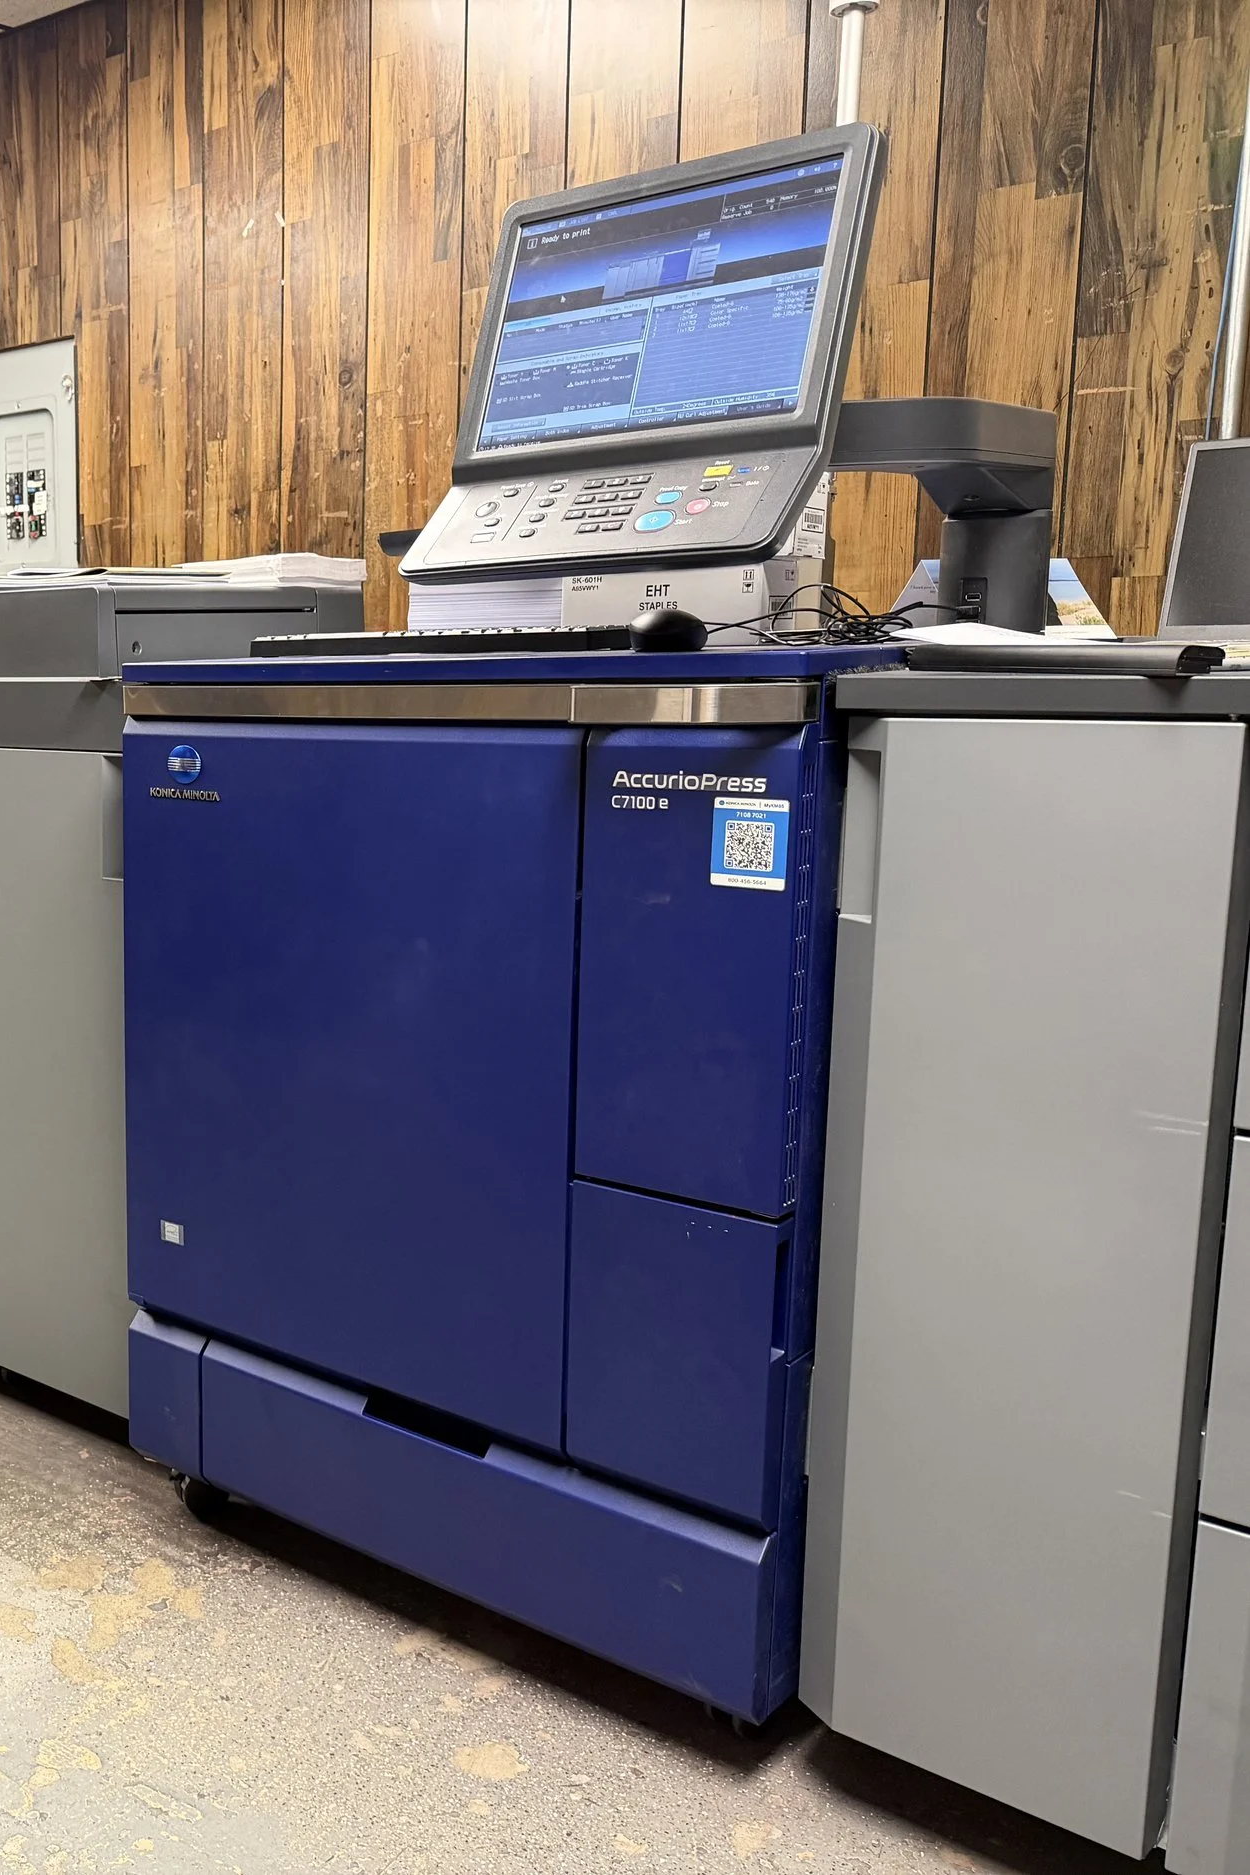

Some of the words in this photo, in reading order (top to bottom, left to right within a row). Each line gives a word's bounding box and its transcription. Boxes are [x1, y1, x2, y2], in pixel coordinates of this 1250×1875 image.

[541, 234, 560, 245] Ready
[572, 227, 591, 240] print
[638, 416, 665, 424] Controller
[698, 408, 726, 417] Adjustment
[646, 584, 670, 598] EHT
[612, 770, 768, 794] AccurioPress
[150, 786, 182, 799] KONICA
[182, 789, 220, 802] MINOLTA
[612, 795, 656, 810] C7100
[659, 798, 669, 810] e
